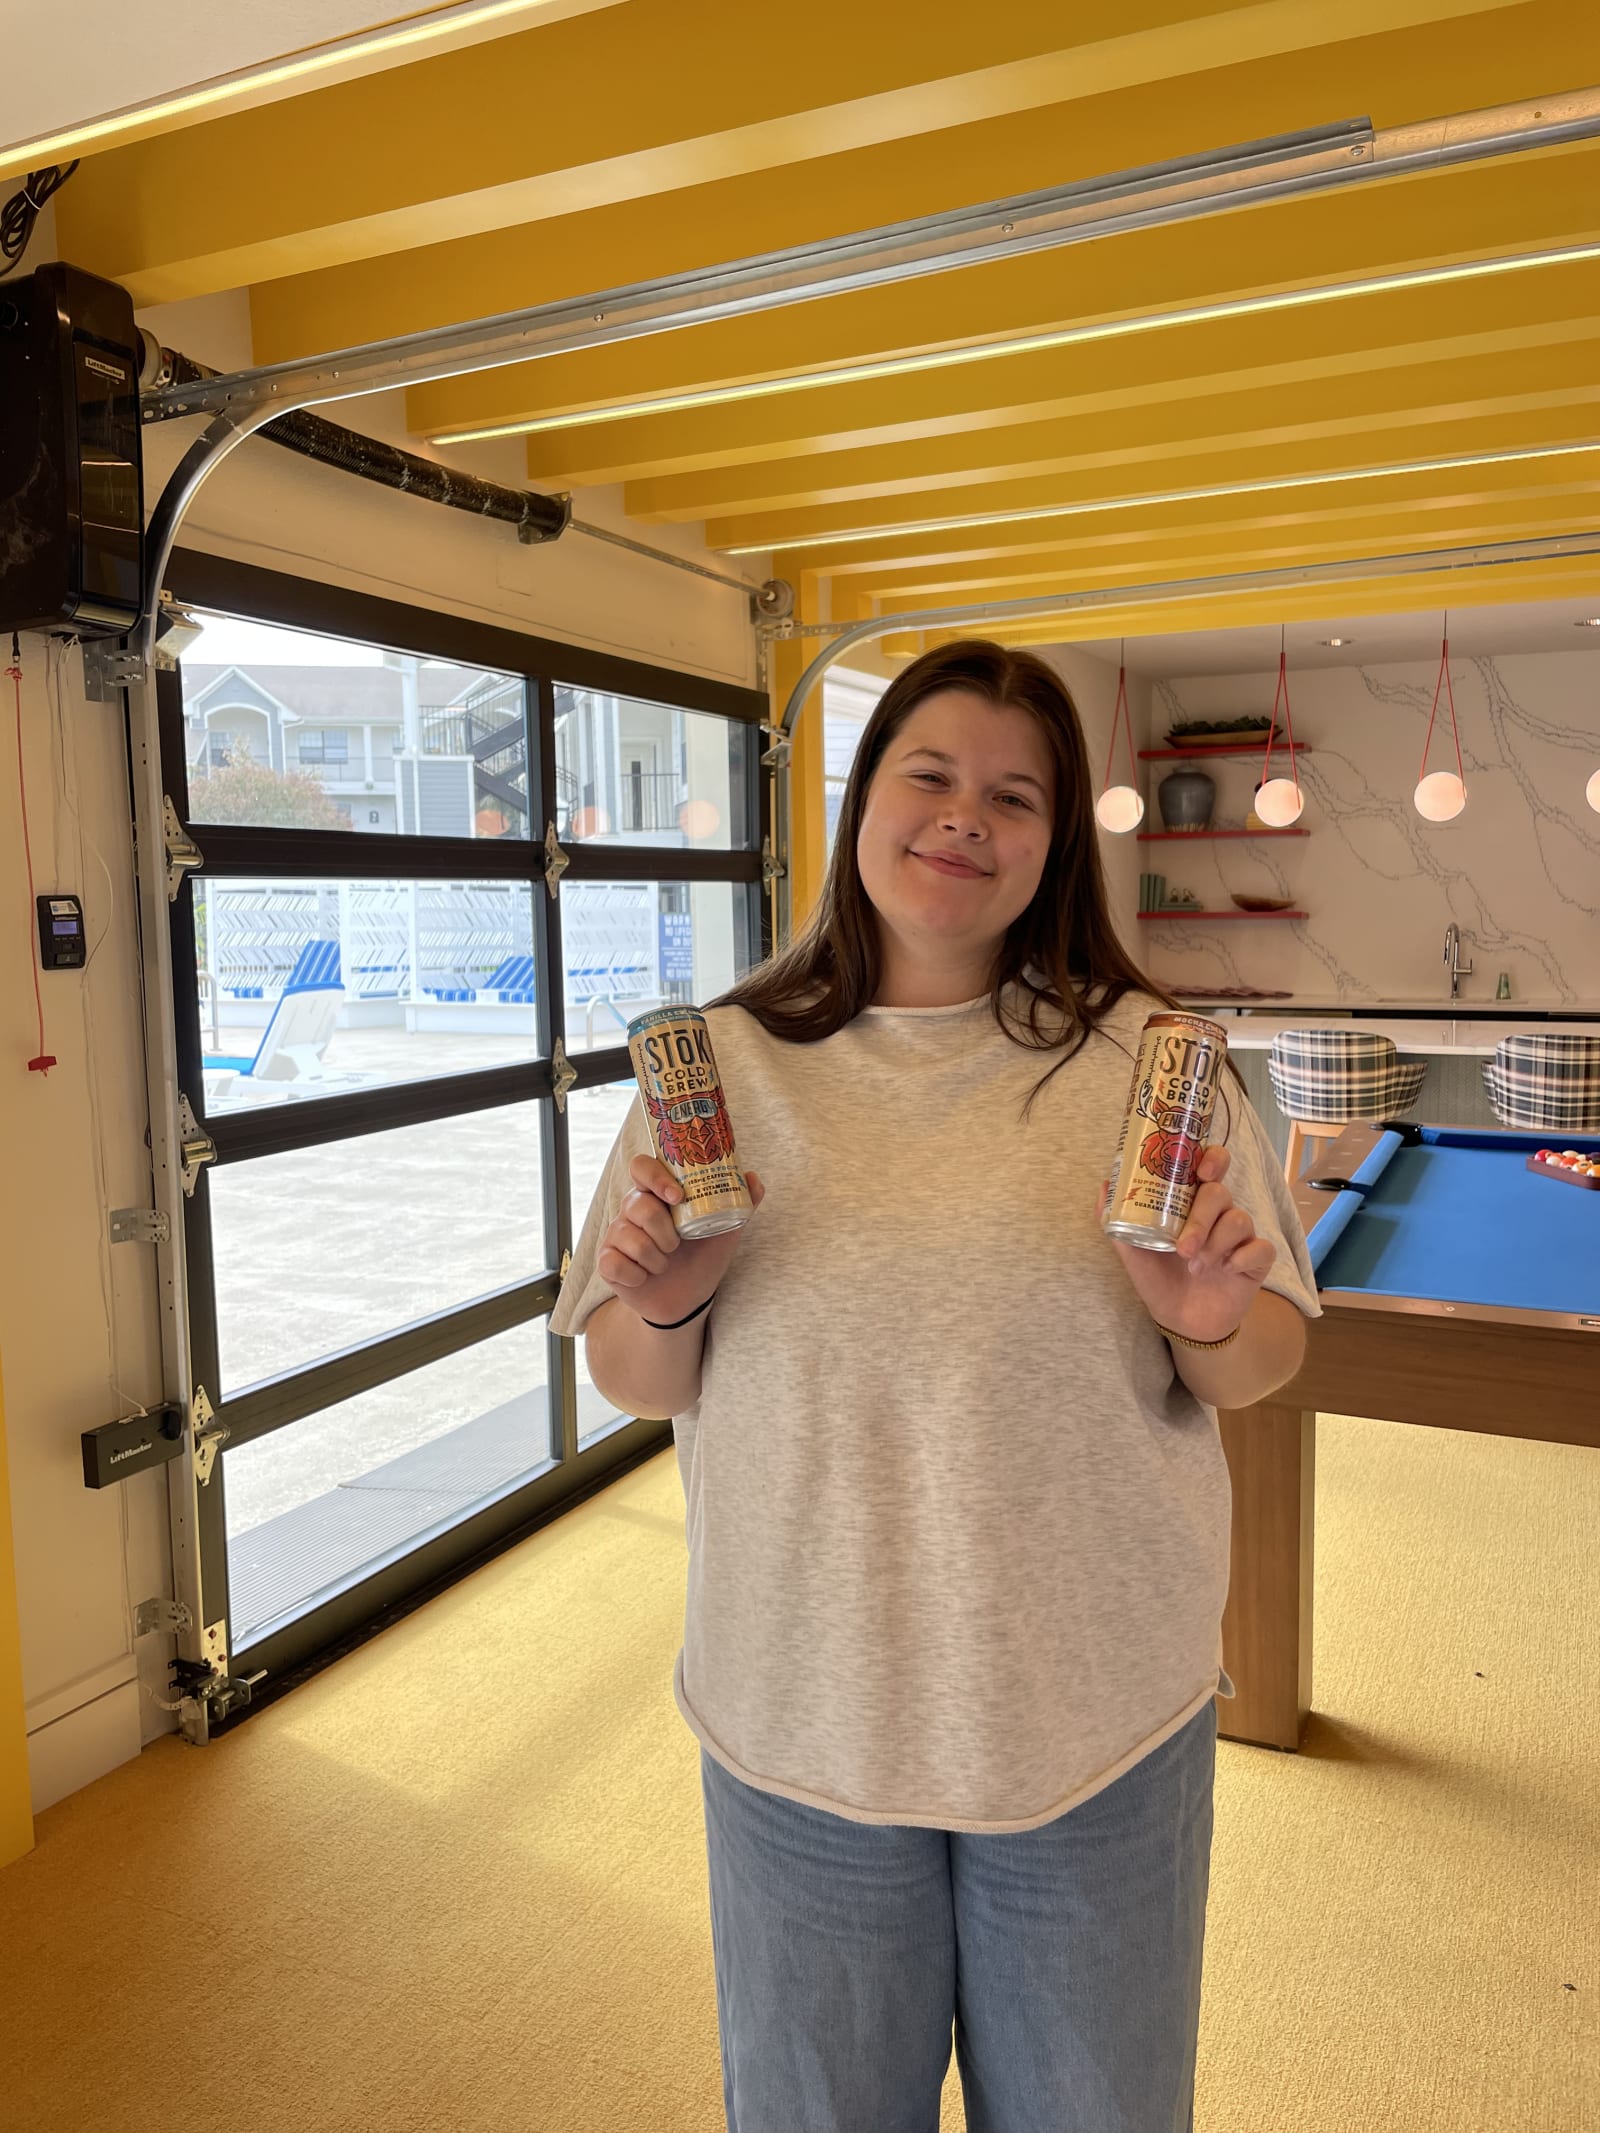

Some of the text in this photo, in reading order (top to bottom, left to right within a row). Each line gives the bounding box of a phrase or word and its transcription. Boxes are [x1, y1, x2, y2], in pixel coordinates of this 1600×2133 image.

[1173, 1016, 1204, 1027] MOCHA
[664, 1066, 706, 1083] COLD
[666, 1078, 708, 1095] BREW
[1169, 1077, 1210, 1098] COLD
[1166, 1089, 1208, 1111] BREW
[109, 1442, 153, 1464] LiftMaster
